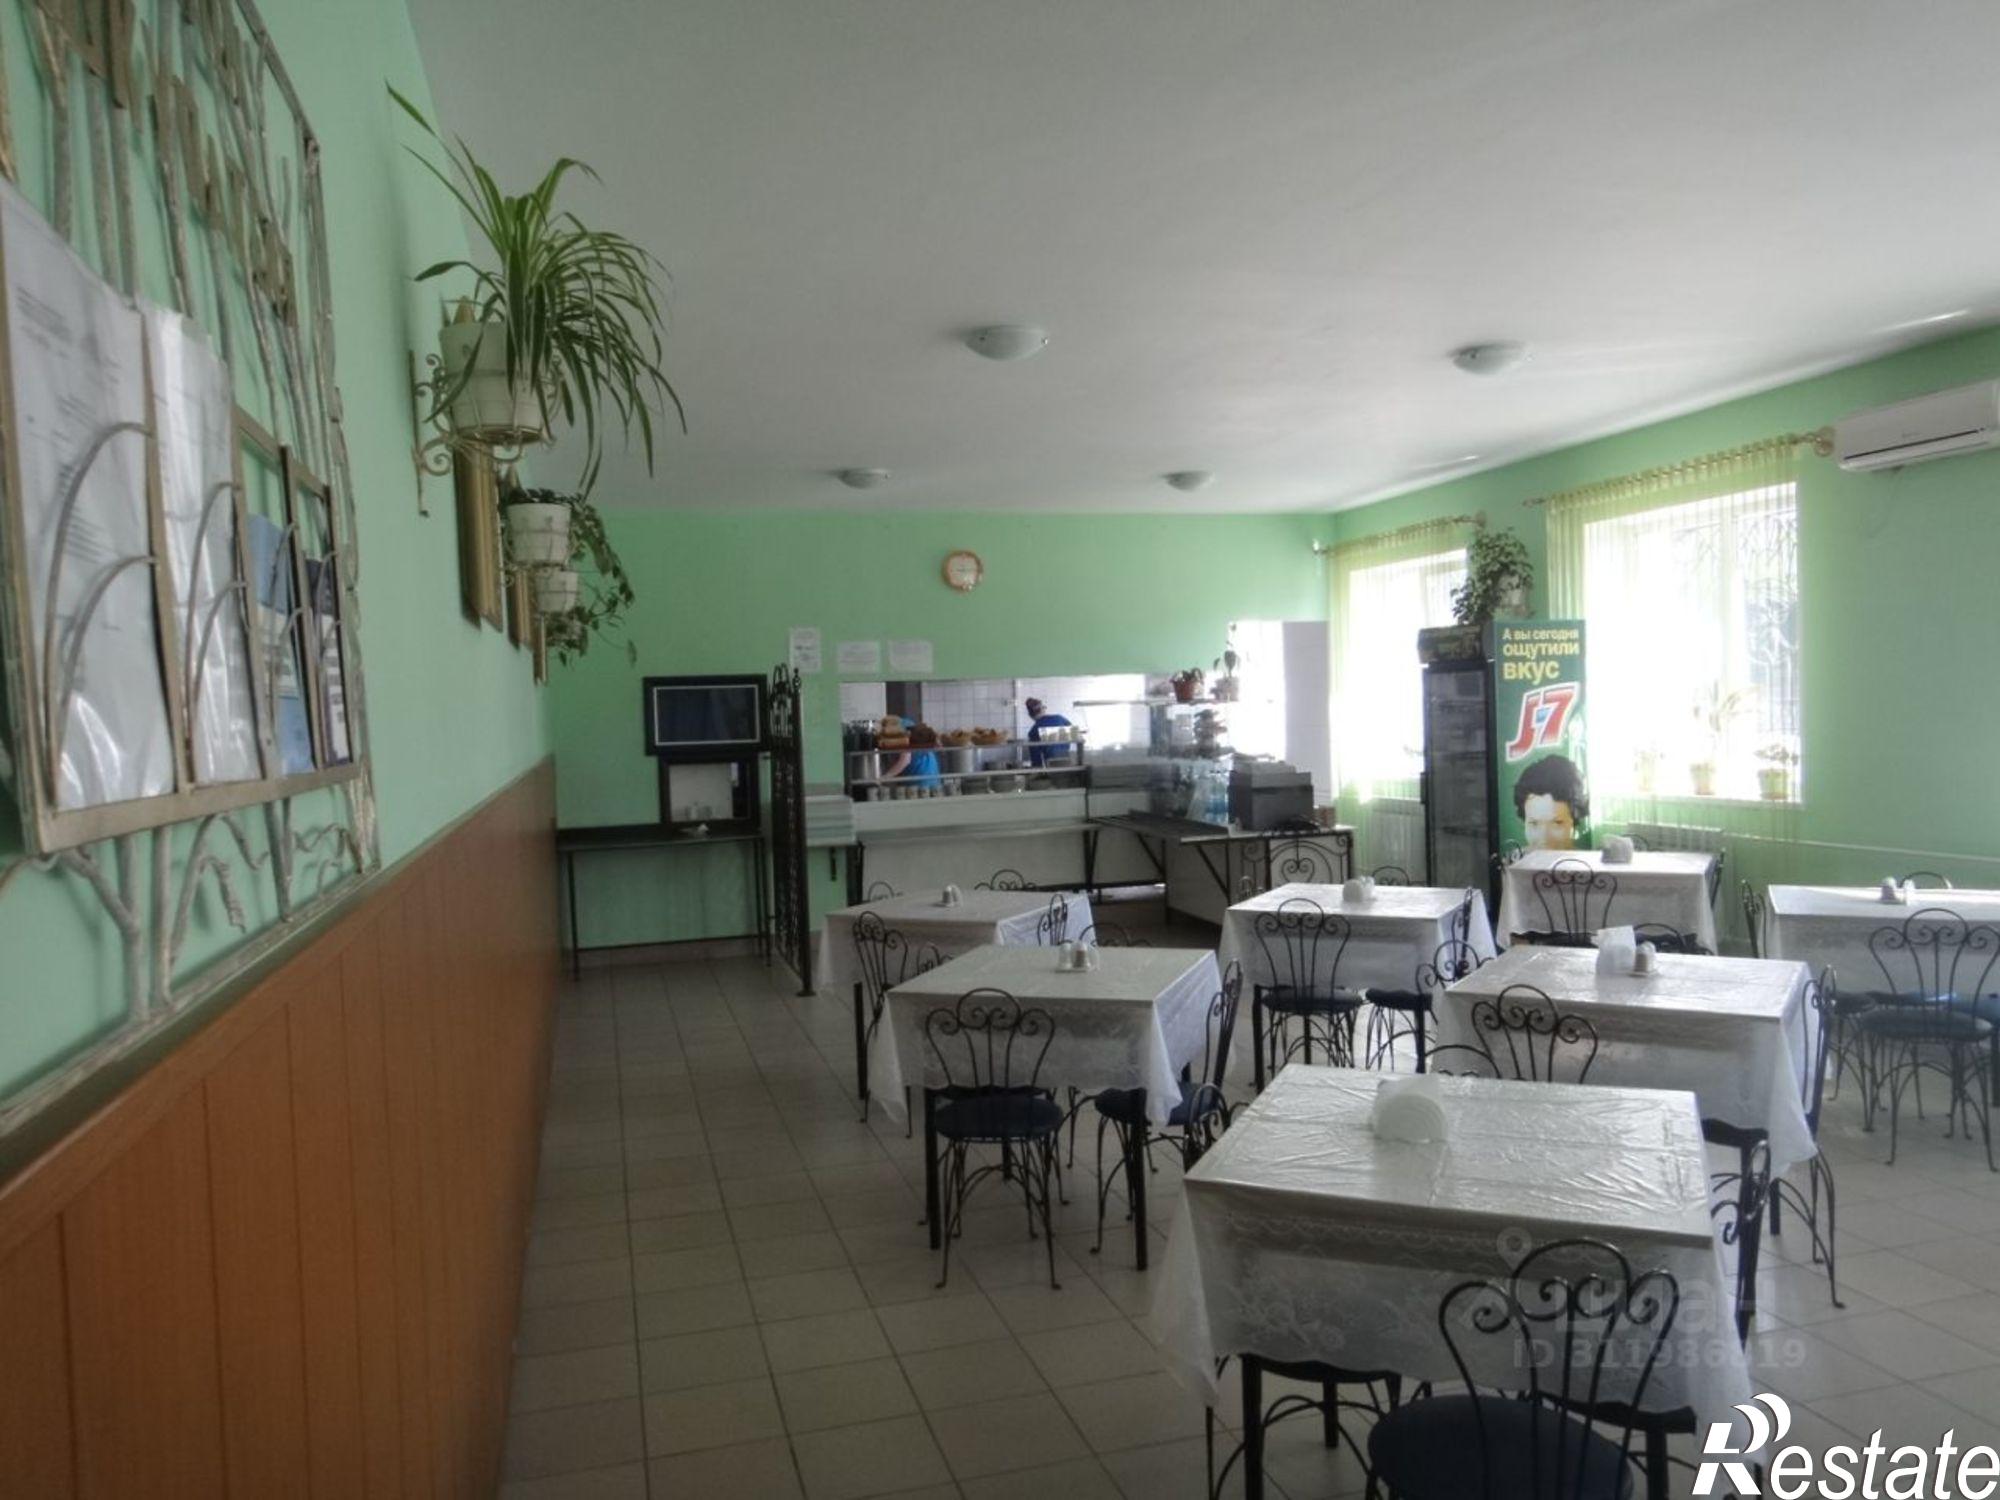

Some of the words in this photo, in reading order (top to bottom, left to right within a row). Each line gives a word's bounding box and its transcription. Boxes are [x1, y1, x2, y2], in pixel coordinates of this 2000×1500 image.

[1502, 628, 1512, 640] А
[1513, 629, 1531, 640] вы
[1533, 629, 1578, 641] сегодня
[1503, 643, 1579, 660] ощутили
[1504, 662, 1560, 685] вкус
[1506, 682, 1579, 762] J7
